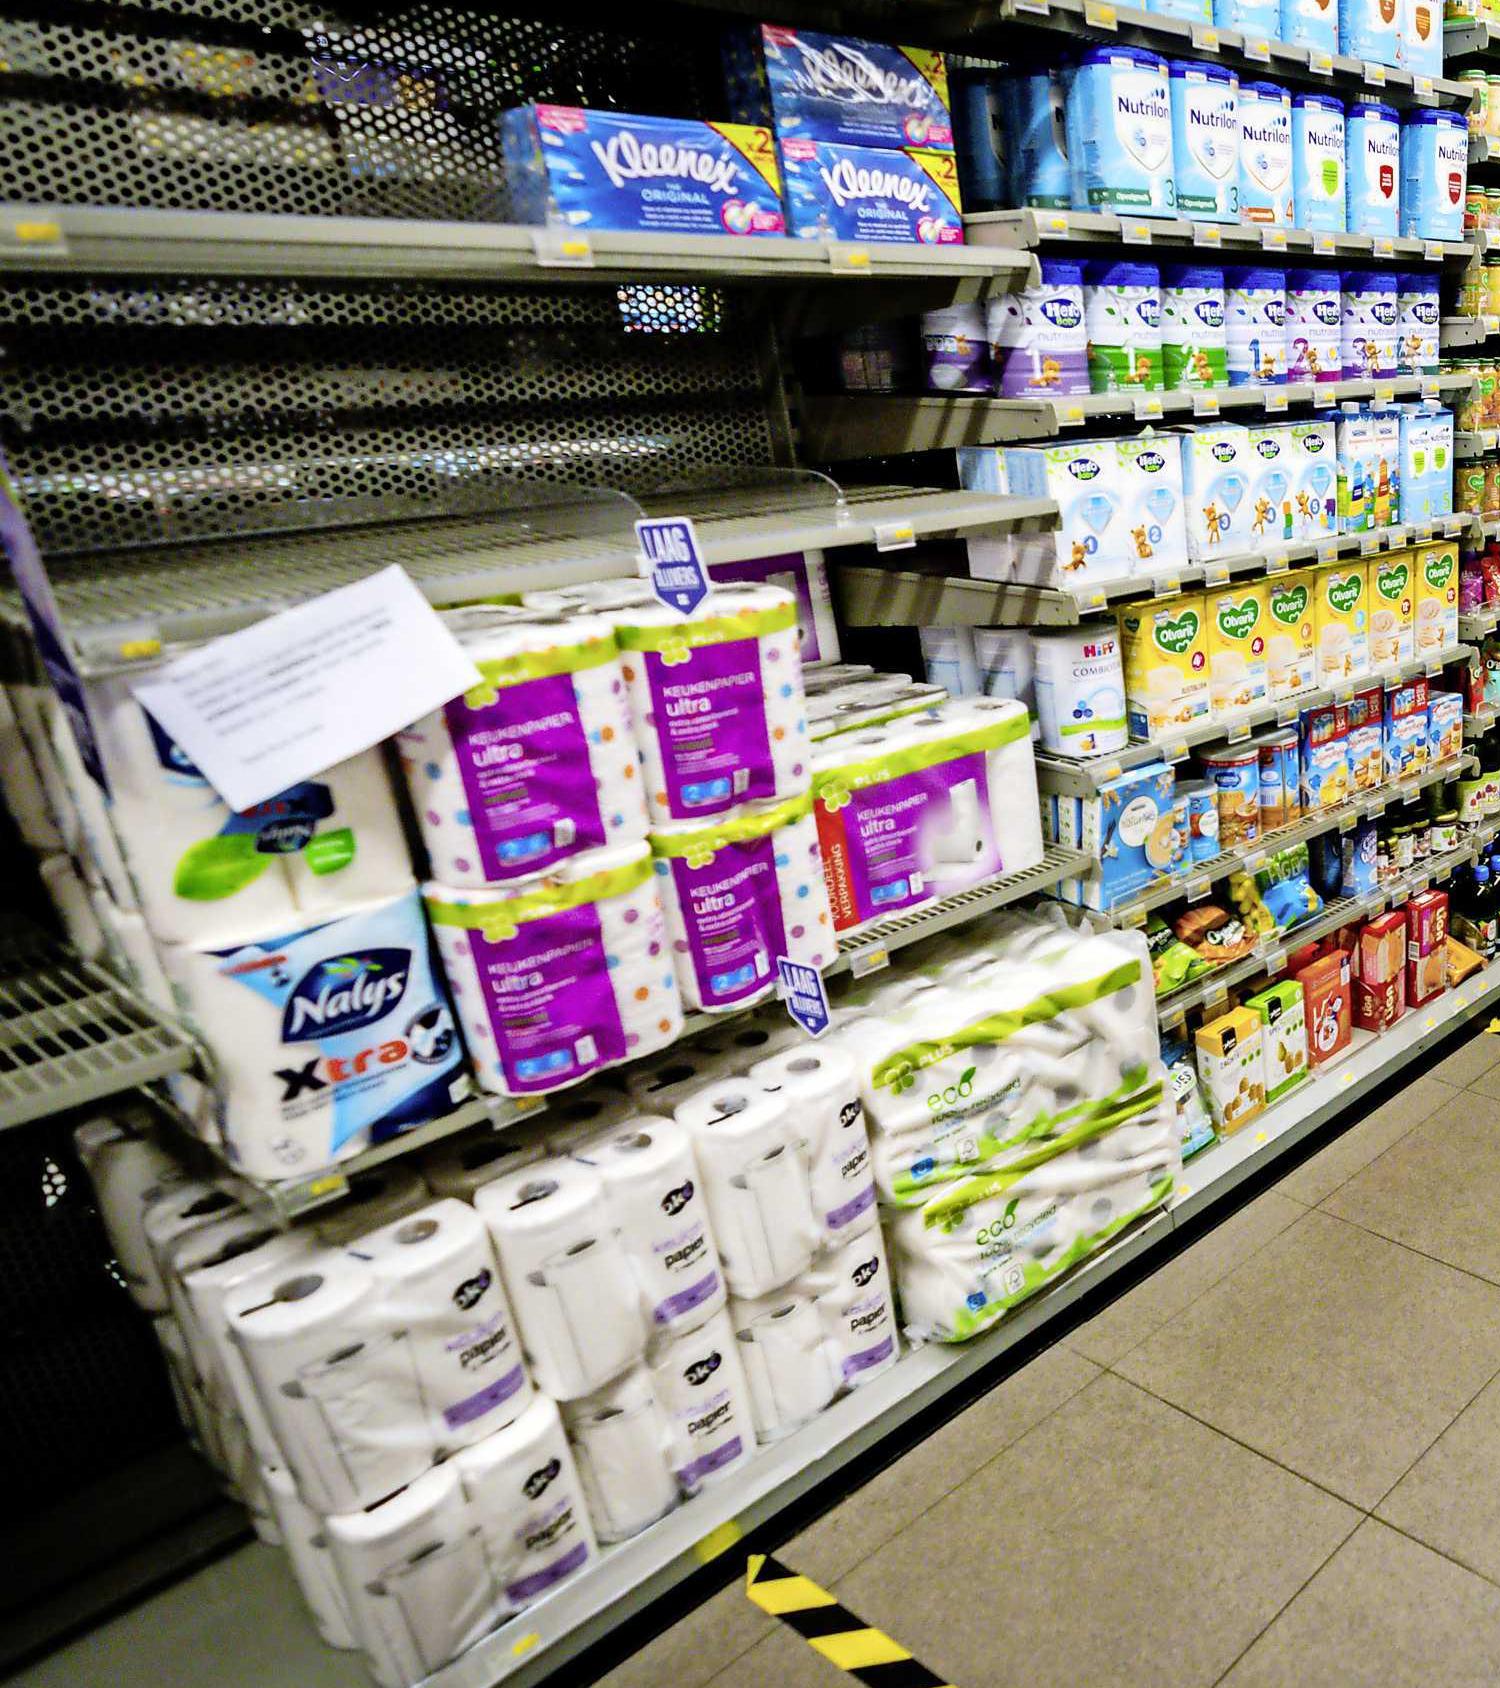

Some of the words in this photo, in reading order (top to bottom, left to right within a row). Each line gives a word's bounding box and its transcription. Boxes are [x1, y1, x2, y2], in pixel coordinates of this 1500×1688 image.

[1118, 96, 1169, 119] Nutrilon
[1190, 109, 1237, 129] Nutrilon
[1243, 126, 1290, 143] Nutrilon
[1308, 131, 1344, 148] Nutrilon
[590, 131, 738, 195] Kleenex
[1438, 146, 1468, 161] Nutrilon
[820, 158, 930, 212] Kleenex
[1166, 179, 1175, 207] 3
[641, 188, 710, 205] ORIGINAL
[1230, 186, 1238, 213] 3
[1285, 200, 1293, 222] 4
[1046, 302, 1081, 317] Hero
[1249, 338, 1261, 372] 1
[1293, 338, 1309, 375] 2
[1213, 443, 1235, 457] Hero
[1259, 441, 1280, 453] Hero
[1304, 436, 1325, 448] Hero
[1070, 459, 1098, 474] Hero
[1138, 452, 1163, 467] Hero
[1312, 501, 1319, 514] 5
[642, 526, 691, 562] LAAG
[1151, 527, 1160, 541] 2
[1381, 577, 1406, 589] Olvarit
[1429, 568, 1451, 580] Olvarit
[1332, 587, 1358, 601] Olvarit
[1276, 599, 1304, 614] Olvarit
[1224, 613, 1256, 628] Olvarit
[1160, 623, 1195, 644] Olvarit
[663, 671, 755, 698] KEUKENPAPIER
[665, 696, 712, 717] ultra
[468, 711, 575, 747] KEUKENPAPIER
[472, 743, 525, 768] ultra
[857, 792, 928, 822] KEUKENPAPIER
[860, 817, 896, 838] ultra
[690, 862, 769, 899] KEUKENPAPIER
[831, 843, 852, 918] VERPAKKING
[693, 892, 736, 915] ultra
[487, 938, 593, 976] KEUKENPAPIER
[491, 972, 544, 994] ultra
[783, 964, 819, 998] LAAG
[289, 969, 406, 1035] Nalys
[928, 1081, 973, 1112] eco
[976, 1212, 1016, 1245] eco
[687, 1400, 731, 1435] papier
